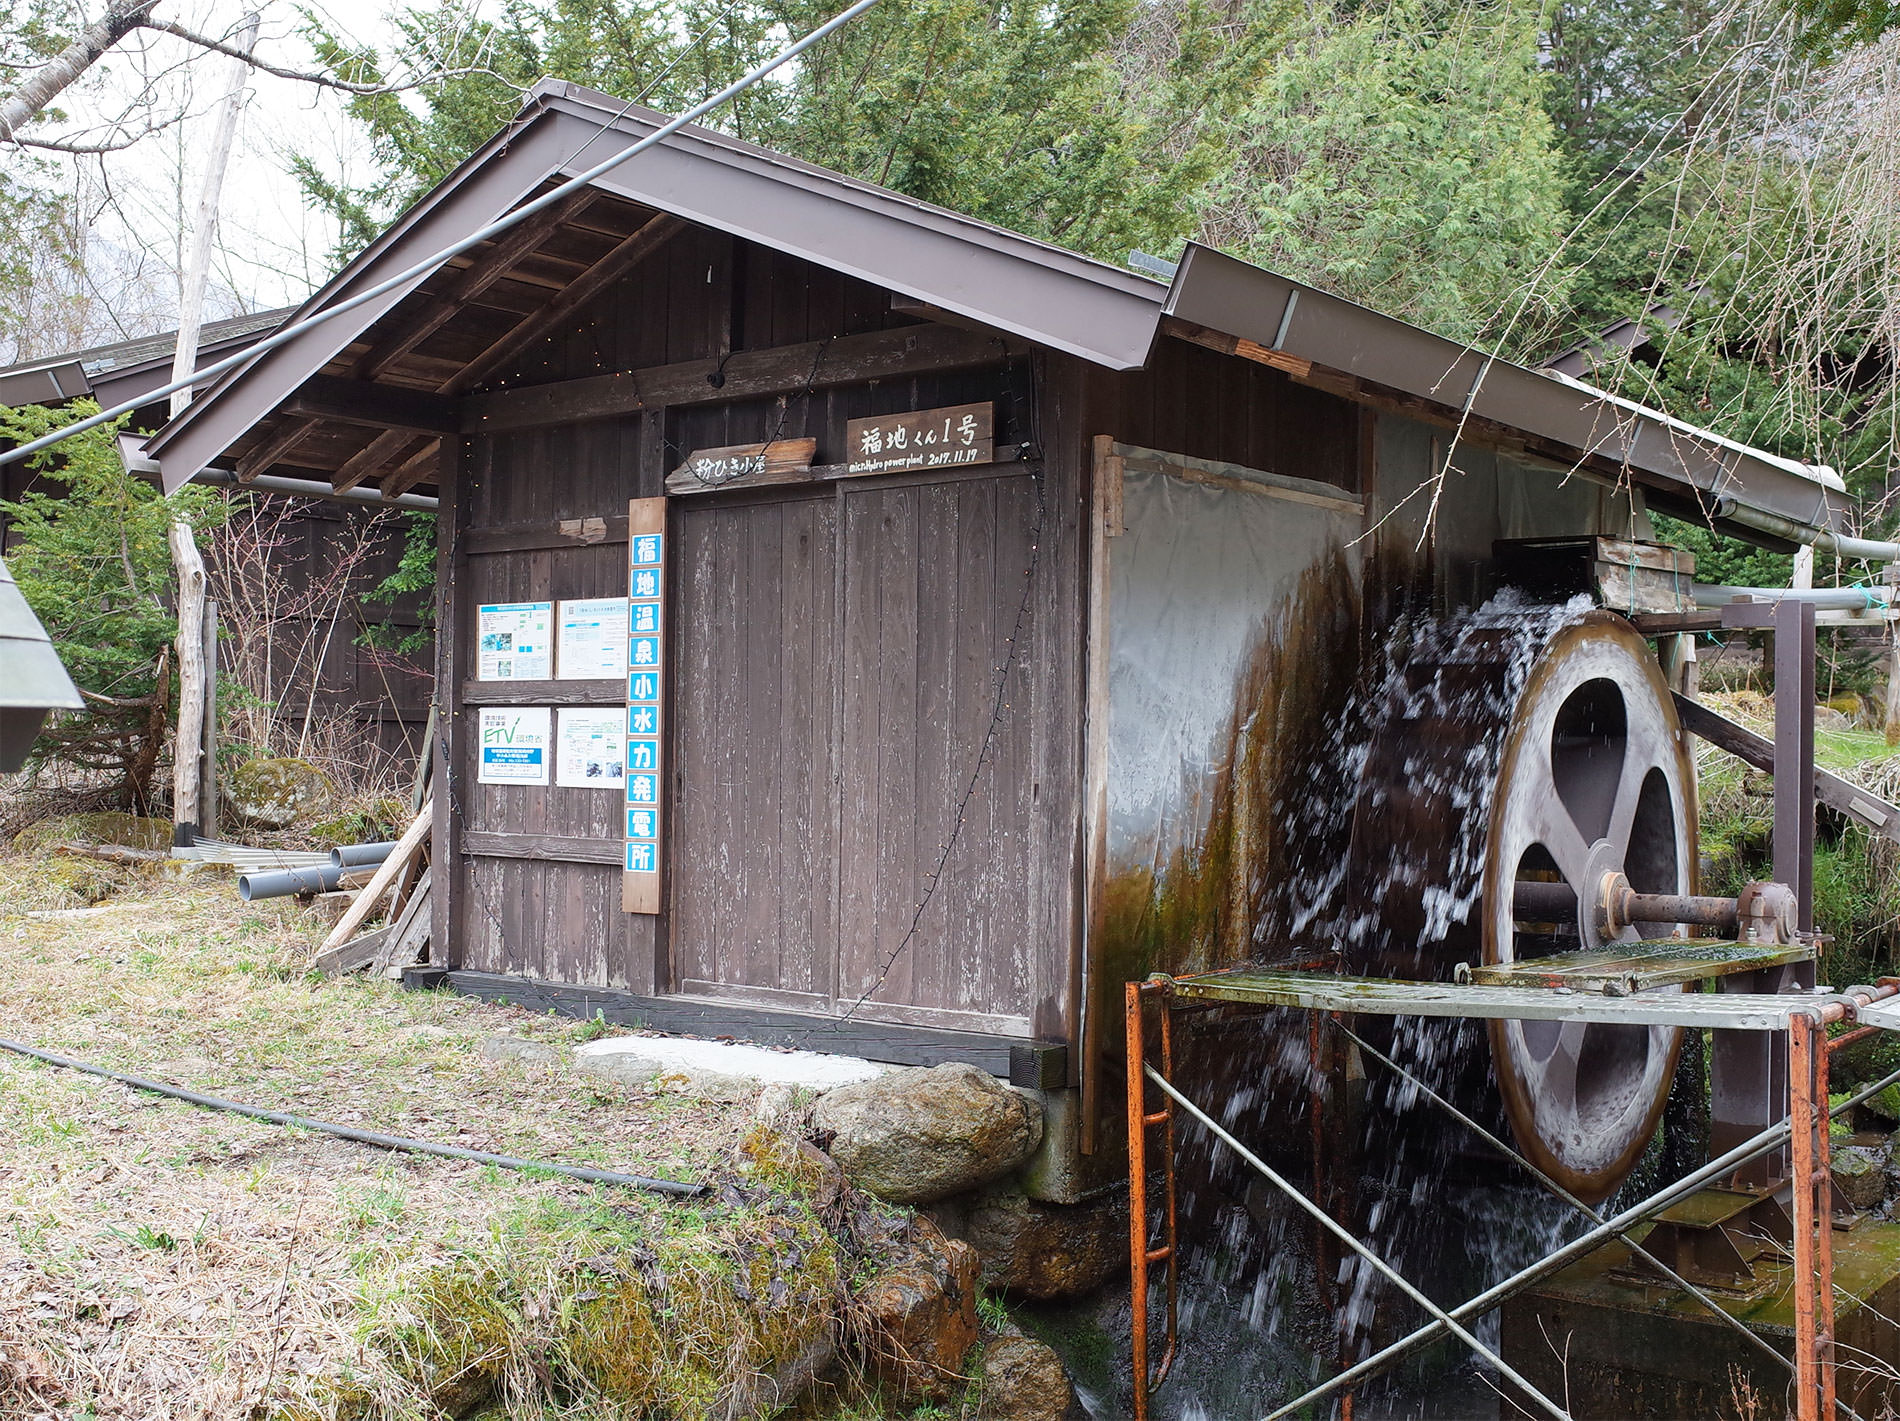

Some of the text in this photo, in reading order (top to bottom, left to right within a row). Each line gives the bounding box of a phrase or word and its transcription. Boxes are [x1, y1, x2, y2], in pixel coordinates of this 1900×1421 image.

[860, 414, 978, 456] 福地くん1号
[695, 455, 766, 480] 粉ひき小屋
[884, 458, 907, 471] power
[906, 453, 924, 469] plant
[927, 449, 978, 466] 2017.11.17
[631, 537, 656, 870] 福地温泉小水力発電所
